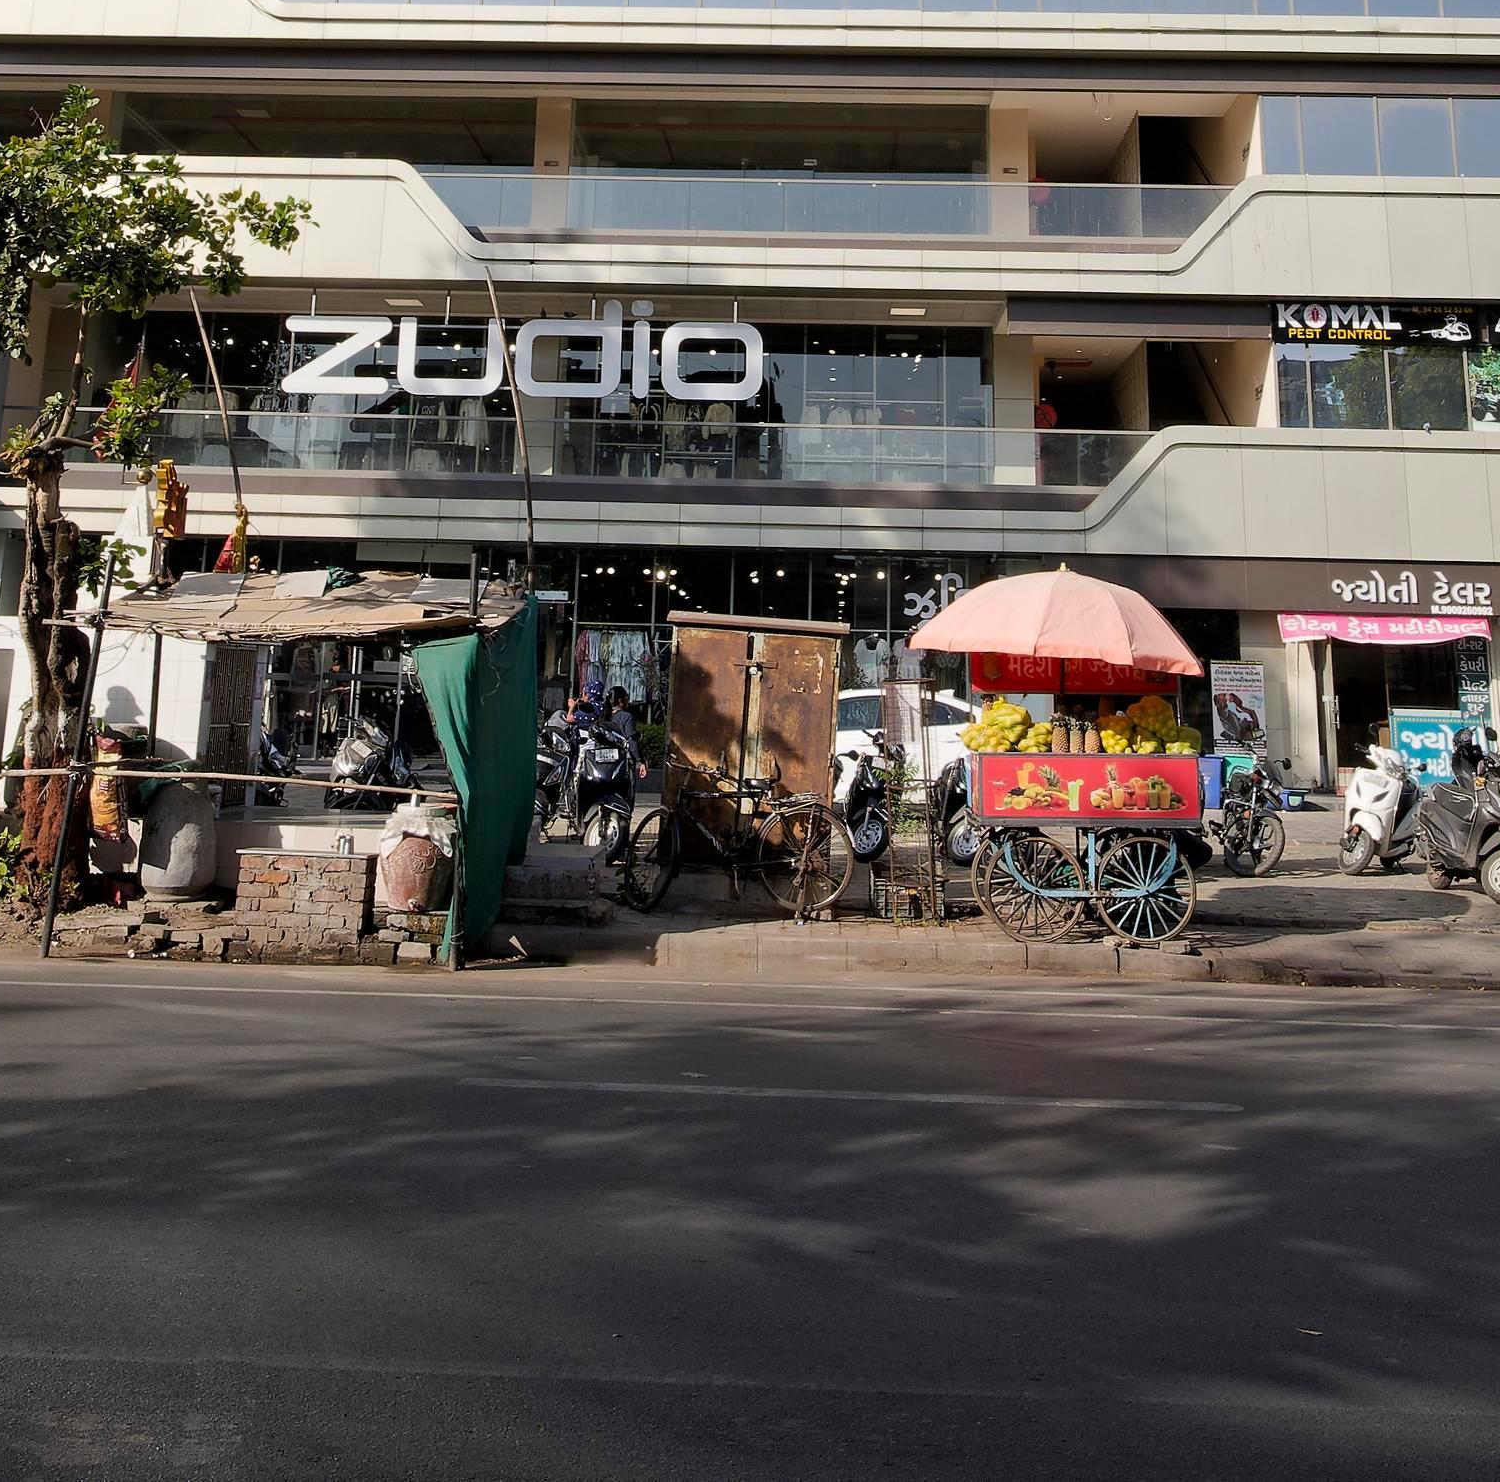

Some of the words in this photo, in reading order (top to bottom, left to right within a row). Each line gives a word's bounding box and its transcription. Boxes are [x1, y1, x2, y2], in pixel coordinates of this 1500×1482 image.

[1276, 303, 1403, 331] KOMAL
[1288, 328, 1322, 339] PEST
[1328, 329, 1392, 341] CONTROL
[1330, 570, 1419, 605] જ્યોતી
[1431, 570, 1493, 606] ટેલર
